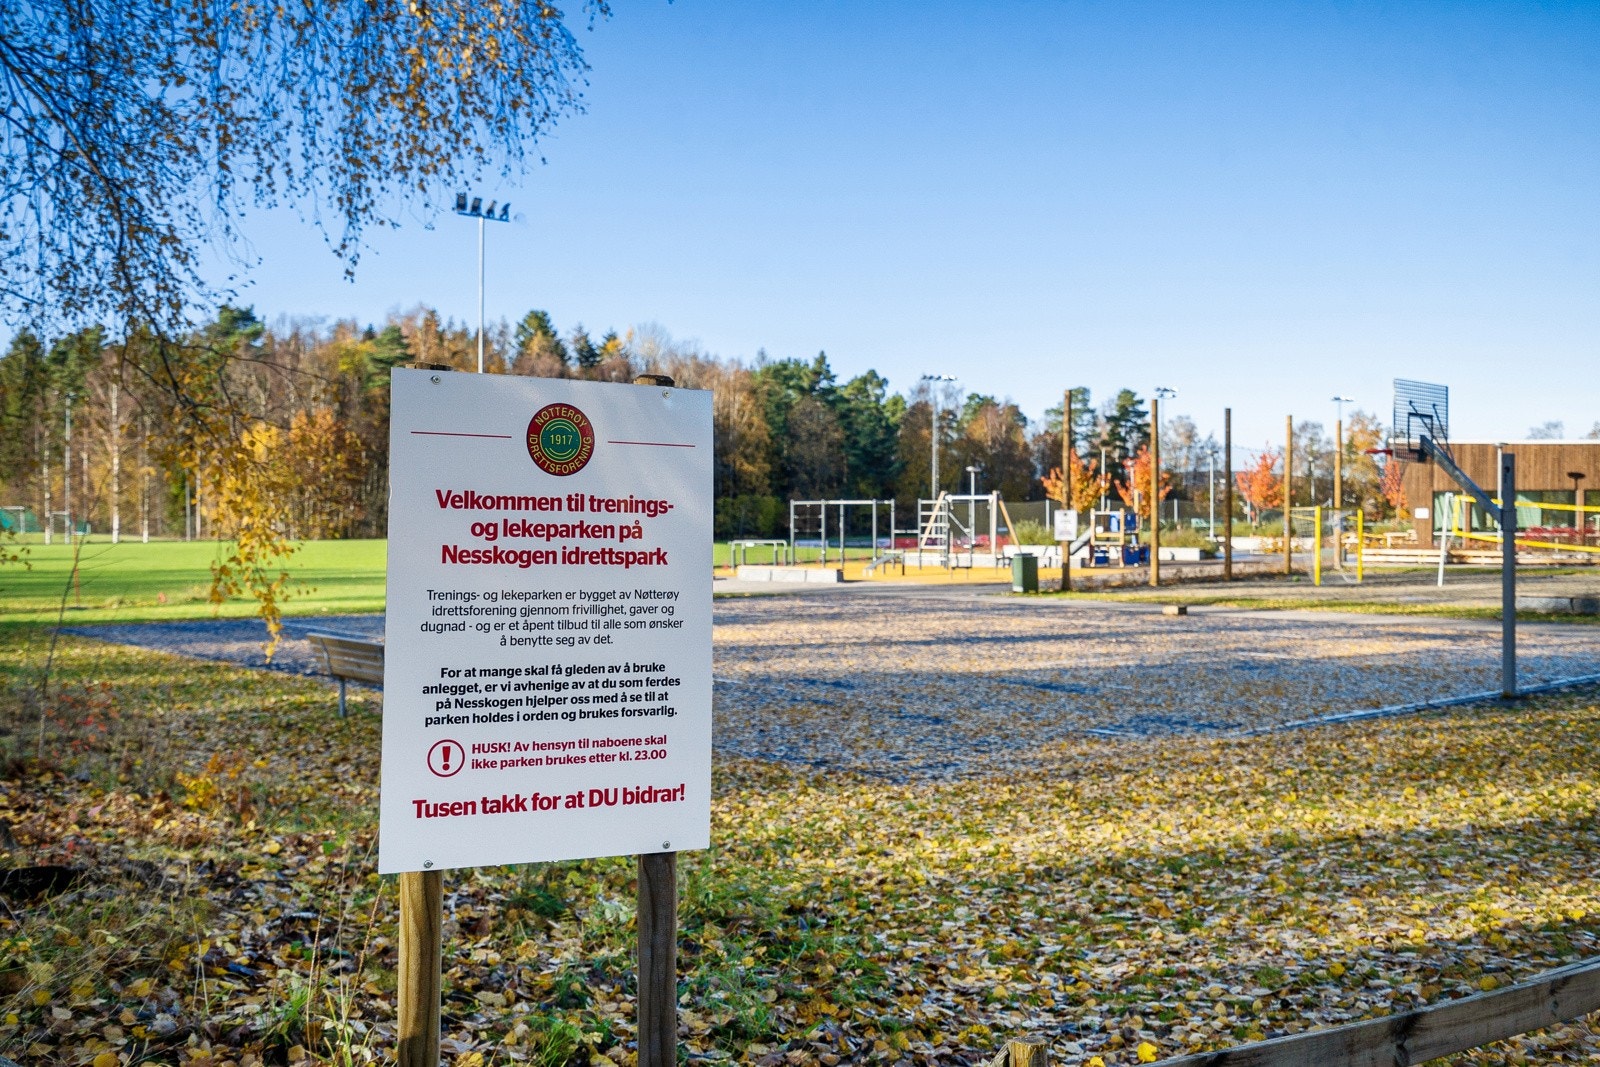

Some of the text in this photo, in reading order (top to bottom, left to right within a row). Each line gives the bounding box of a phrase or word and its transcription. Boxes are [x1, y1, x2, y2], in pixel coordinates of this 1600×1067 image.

[535, 407, 587, 428] NØTTERØY
[549, 435, 573, 445] 1917
[529, 434, 592, 474] IDRETTSFORENING
[435, 489, 674, 518] Velkommen til trenings-
[471, 519, 642, 543] og lekeparken på
[442, 545, 668, 569] Nesskogen idrettspark
[427, 590, 480, 602] Trenings-
[483, 592, 498, 602] og
[502, 590, 562, 602] lekeparken
[565, 592, 576, 600] er
[580, 590, 616, 602] bygget
[635, 589, 679, 601] Nøtterøy
[432, 604, 674, 617] idrettsforening gjennom frivillighet, gaver og
[421, 621, 465, 634] dugnad
[476, 623, 490, 633] og
[494, 623, 506, 631] er
[509, 621, 519, 630] et
[523, 619, 554, 632] åpent
[557, 619, 588, 630] tilbud
[591, 619, 600, 629] til
[603, 619, 621, 629] alle
[624, 621, 646, 629] som
[649, 618, 683, 629] ønsker
[500, 635, 506, 646] å
[510, 635, 553, 647] benytte
[556, 637, 575, 647] seg
[594, 634, 613, 644] det.
[441, 662, 665, 678] For at mange skal få gleden av å bruke
[422, 676, 680, 695] anlegget, er vi avhenige av at du som ferdes
[436, 691, 669, 711] på Nesskogen hjelper oss med å se til at
[425, 705, 677, 727] parken holdes i orden og brukes forsvarlig.
[472, 735, 667, 754] HUSK! Av hensyn til naboene skal
[472, 749, 667, 770] ikke parken brukes etter kl. 23.00
[412, 783, 685, 818] Tusen takk for at DU bidrar!
